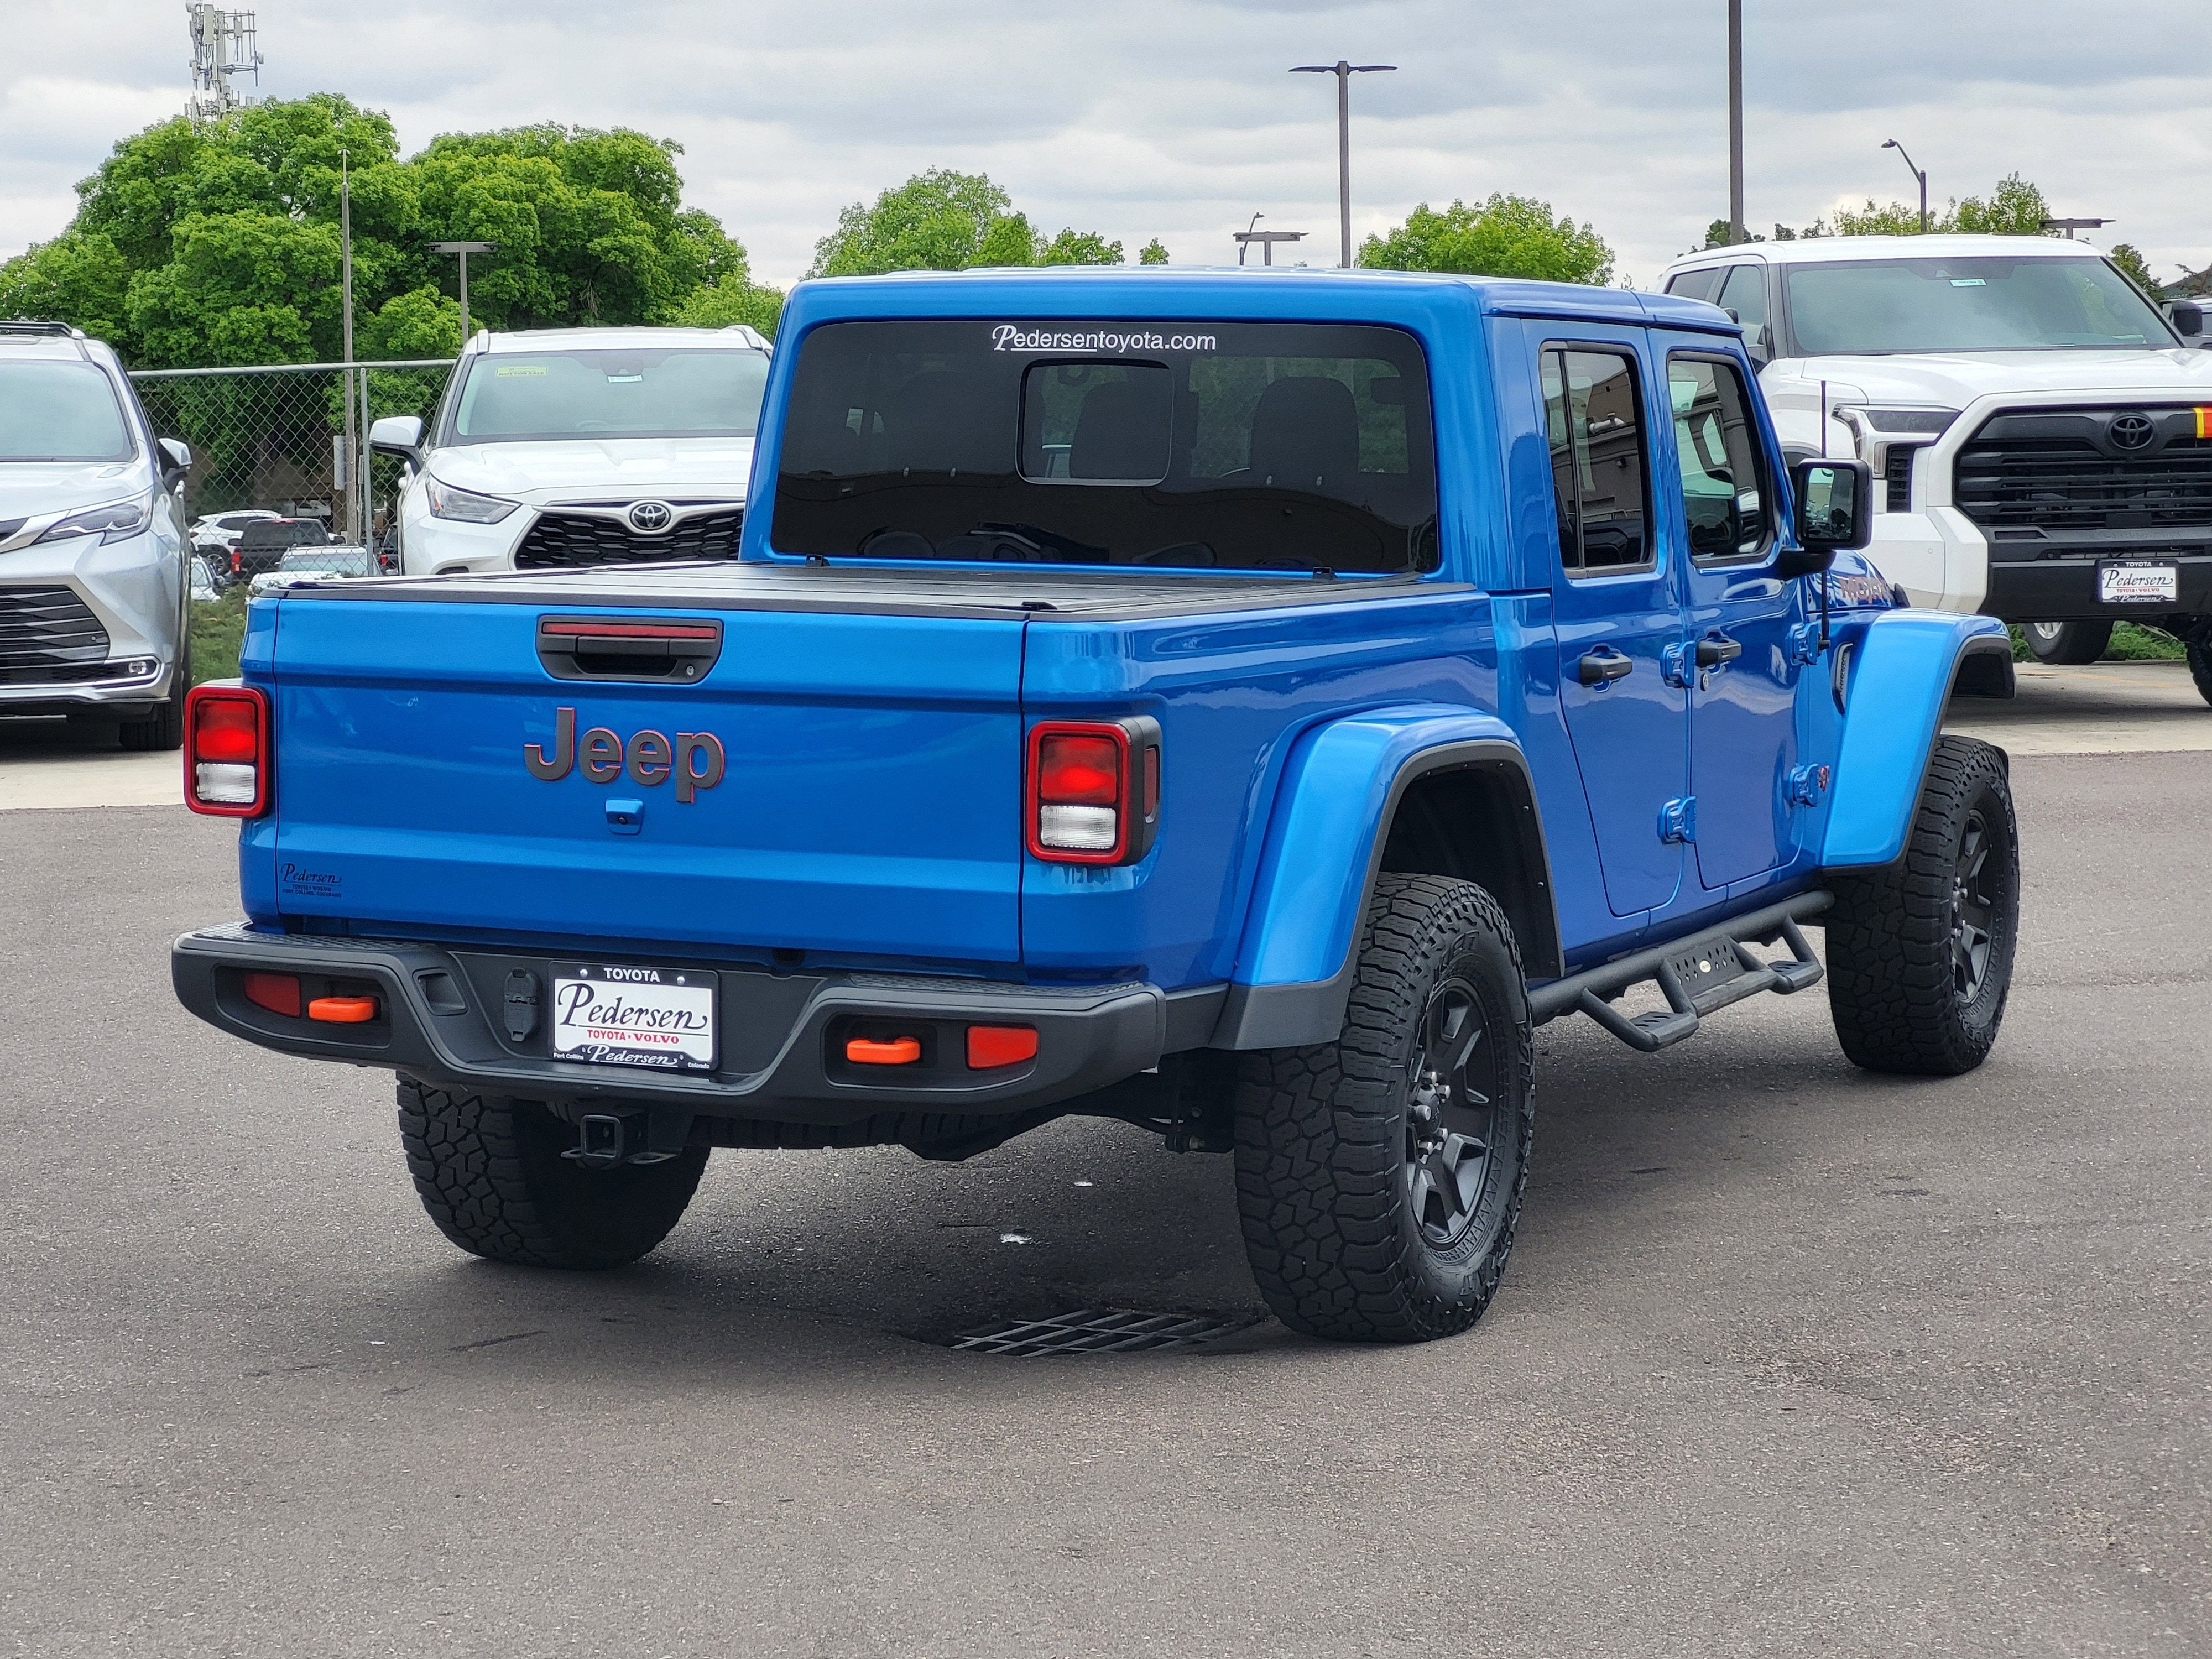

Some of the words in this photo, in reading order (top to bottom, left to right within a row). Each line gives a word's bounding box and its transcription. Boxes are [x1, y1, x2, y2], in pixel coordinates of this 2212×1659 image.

[992, 325, 1216, 353] Pedersentoyota.com
[2103, 570, 2173, 588] Pedersen
[524, 706, 726, 804] Jeep
[280, 863, 342, 884] Pedersen
[603, 968, 660, 983] TOYOTA
[558, 983, 708, 1030] Pedersen
[587, 1030, 626, 1040] TOYOTA
[633, 1033, 680, 1044] VOLVO
[587, 1045, 678, 1065] Pedersen
